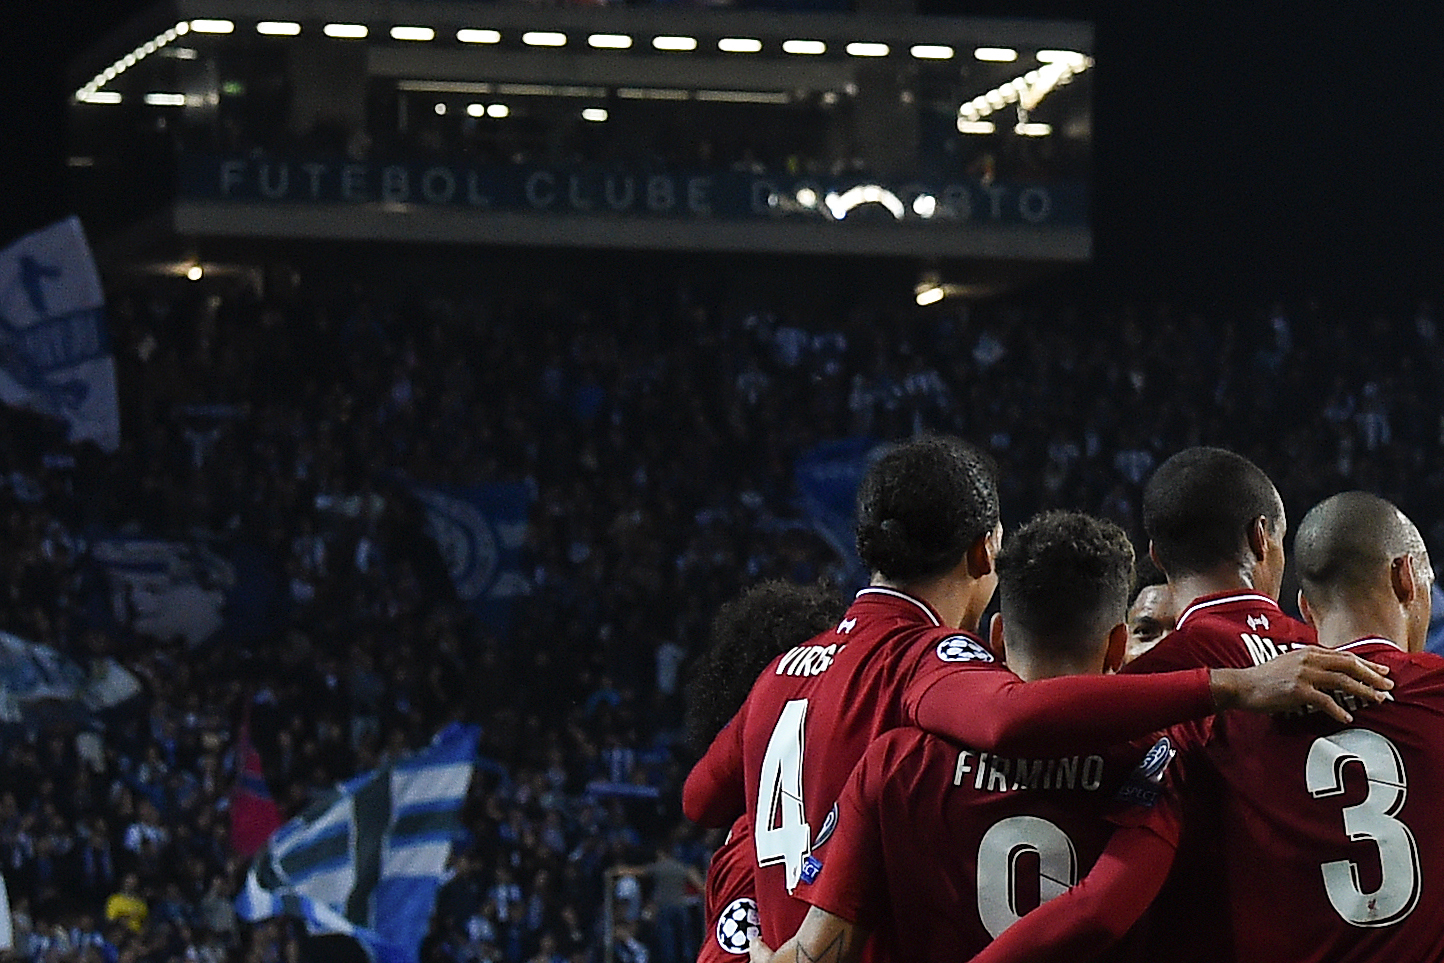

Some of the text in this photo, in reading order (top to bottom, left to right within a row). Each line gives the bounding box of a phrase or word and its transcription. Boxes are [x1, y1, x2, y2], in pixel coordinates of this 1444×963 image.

[219, 160, 490, 206] FUTEBOL
[524, 170, 714, 215] CLUBE
[755, 698, 811, 896] 4
[953, 750, 1105, 793] FIRMINO
[1305, 728, 1422, 928] 3
